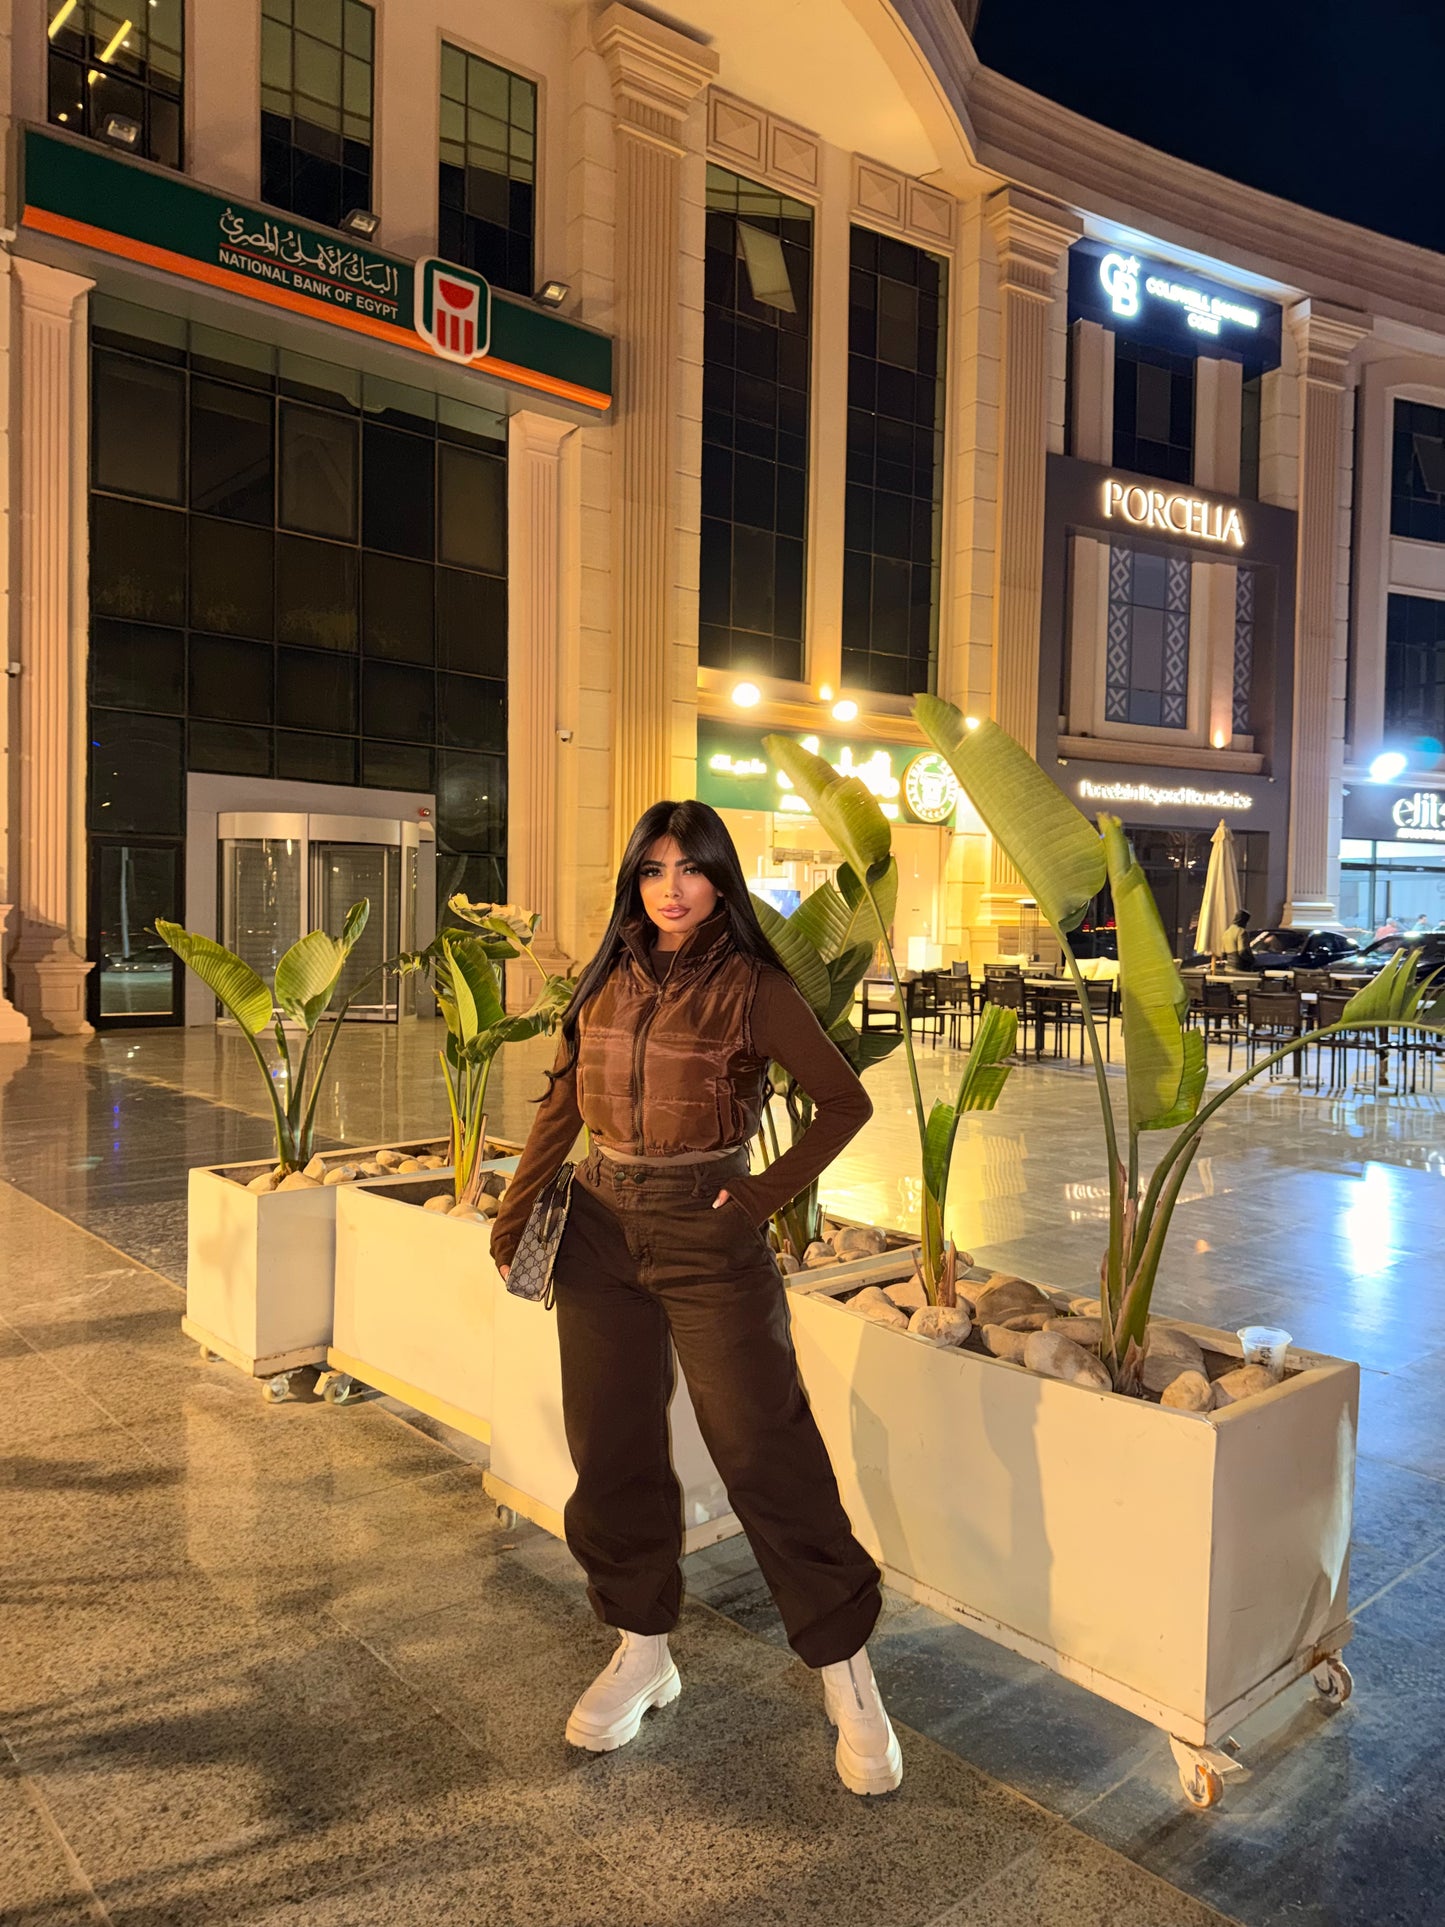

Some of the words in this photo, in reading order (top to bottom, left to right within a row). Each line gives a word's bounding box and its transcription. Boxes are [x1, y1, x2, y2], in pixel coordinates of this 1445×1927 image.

[219, 248, 290, 284] NATIONAL
[293, 273, 332, 298] BANK
[334, 290, 353, 304] OF
[356, 295, 399, 320] EGYPT
[1104, 479, 1245, 547] PORCELIA
